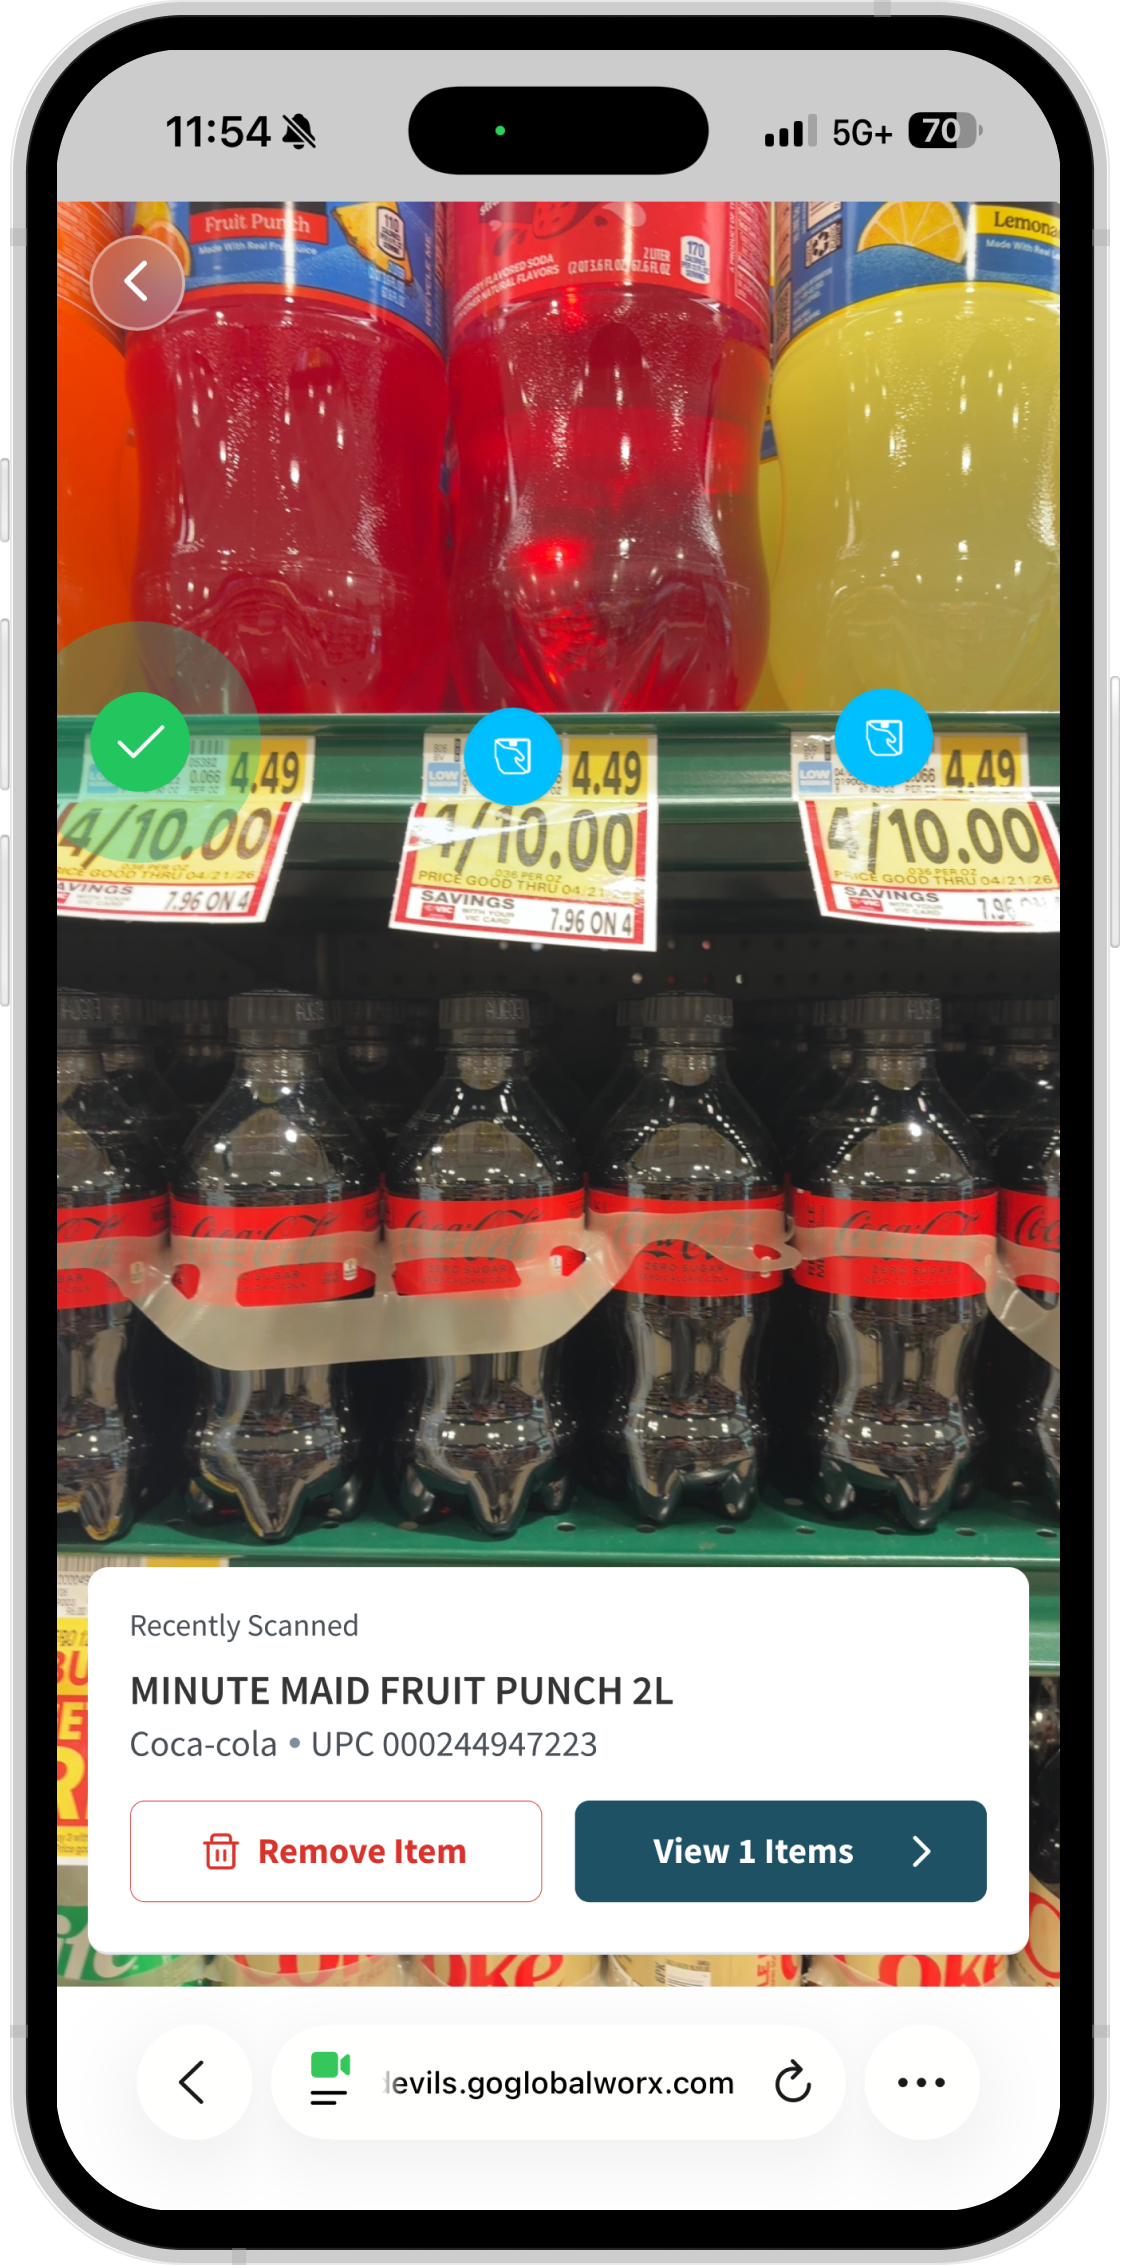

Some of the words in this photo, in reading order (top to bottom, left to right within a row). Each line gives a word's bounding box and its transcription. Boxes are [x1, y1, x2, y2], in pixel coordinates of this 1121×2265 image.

[167, 116, 271, 148] 11:54
[833, 119, 893, 147] 5G+
[922, 118, 961, 143] 70
[205, 213, 248, 233] Fruit
[384, 213, 399, 232] 110
[994, 211, 1060, 240] Lemona
[687, 240, 705, 259] 170
[985, 239, 1011, 249] Made
[1012, 241, 1033, 253] With
[1033, 245, 1051, 257] Real
[527, 253, 555, 268] SODA
[516, 264, 560, 285] FLAVORS
[229, 750, 300, 794] 4.49
[428, 770, 460, 781] LOW
[572, 750, 642, 795] 4.49
[799, 769, 831, 780] LOW
[946, 749, 1016, 794] 4.49
[57, 803, 272, 870] 4/10.00
[427, 802, 634, 876] 4/10.00
[828, 802, 1041, 875] 4/10.00
[57, 868, 87, 876] RICE
[90, 868, 137, 879] GOOD
[142, 870, 183, 881] THRU
[418, 870, 462, 884] PRICE
[466, 875, 513, 889] GOOD
[517, 880, 558, 894] THRU
[492, 868, 520, 879] .036
[521, 871, 542, 881] PER
[545, 874, 563, 884] OZ
[882, 873, 930, 885] GOOD
[933, 875, 977, 886] THRU
[980, 874, 1053, 886] 04/21/26
[907, 867, 934, 876] .036
[935, 868, 957, 876] PER
[960, 868, 977, 876] OZ
[57, 882, 134, 895] AVINGS
[164, 890, 203, 911] 7.96
[206, 891, 236, 911] ON
[237, 890, 251, 909] 4
[421, 889, 515, 910] SAVINGS
[844, 886, 940, 902] SAVINGS
[550, 906, 585, 934] 7.96
[590, 911, 617, 936] ON
[621, 912, 632, 937] 4
[187, 1211, 342, 1270] Coca-Cola
[400, 1208, 546, 1263] Coca-Cola
[613, 1206, 762, 1261] Coca-Cola
[835, 1208, 982, 1264] Coca-Cola
[428, 1264, 459, 1275] ZERO
[464, 1264, 508, 1275] SUGAR
[644, 1261, 677, 1273] ZERO
[682, 1262, 725, 1273] SUGAR
[871, 1265, 908, 1275] ZERO
[912, 1265, 954, 1275] SUGAR
[131, 1611, 241, 1643] Recently
[247, 1611, 358, 1637] Scanned
[131, 1676, 270, 1706] MINUTE
[281, 1676, 370, 1705] MAID
[381, 1676, 486, 1706] FRUIT
[496, 1676, 622, 1706] PUNCH
[632, 1676, 674, 1705] 2L
[130, 1729, 277, 1757] Coca-cola
[312, 1730, 375, 1757] UPC
[382, 1731, 597, 1757] 000244947223
[259, 1838, 386, 1865] Remove
[395, 1838, 466, 1865] Item
[652, 1836, 730, 1865] View
[739, 1839, 756, 1864] 1
[766, 1838, 854, 1865] Items
